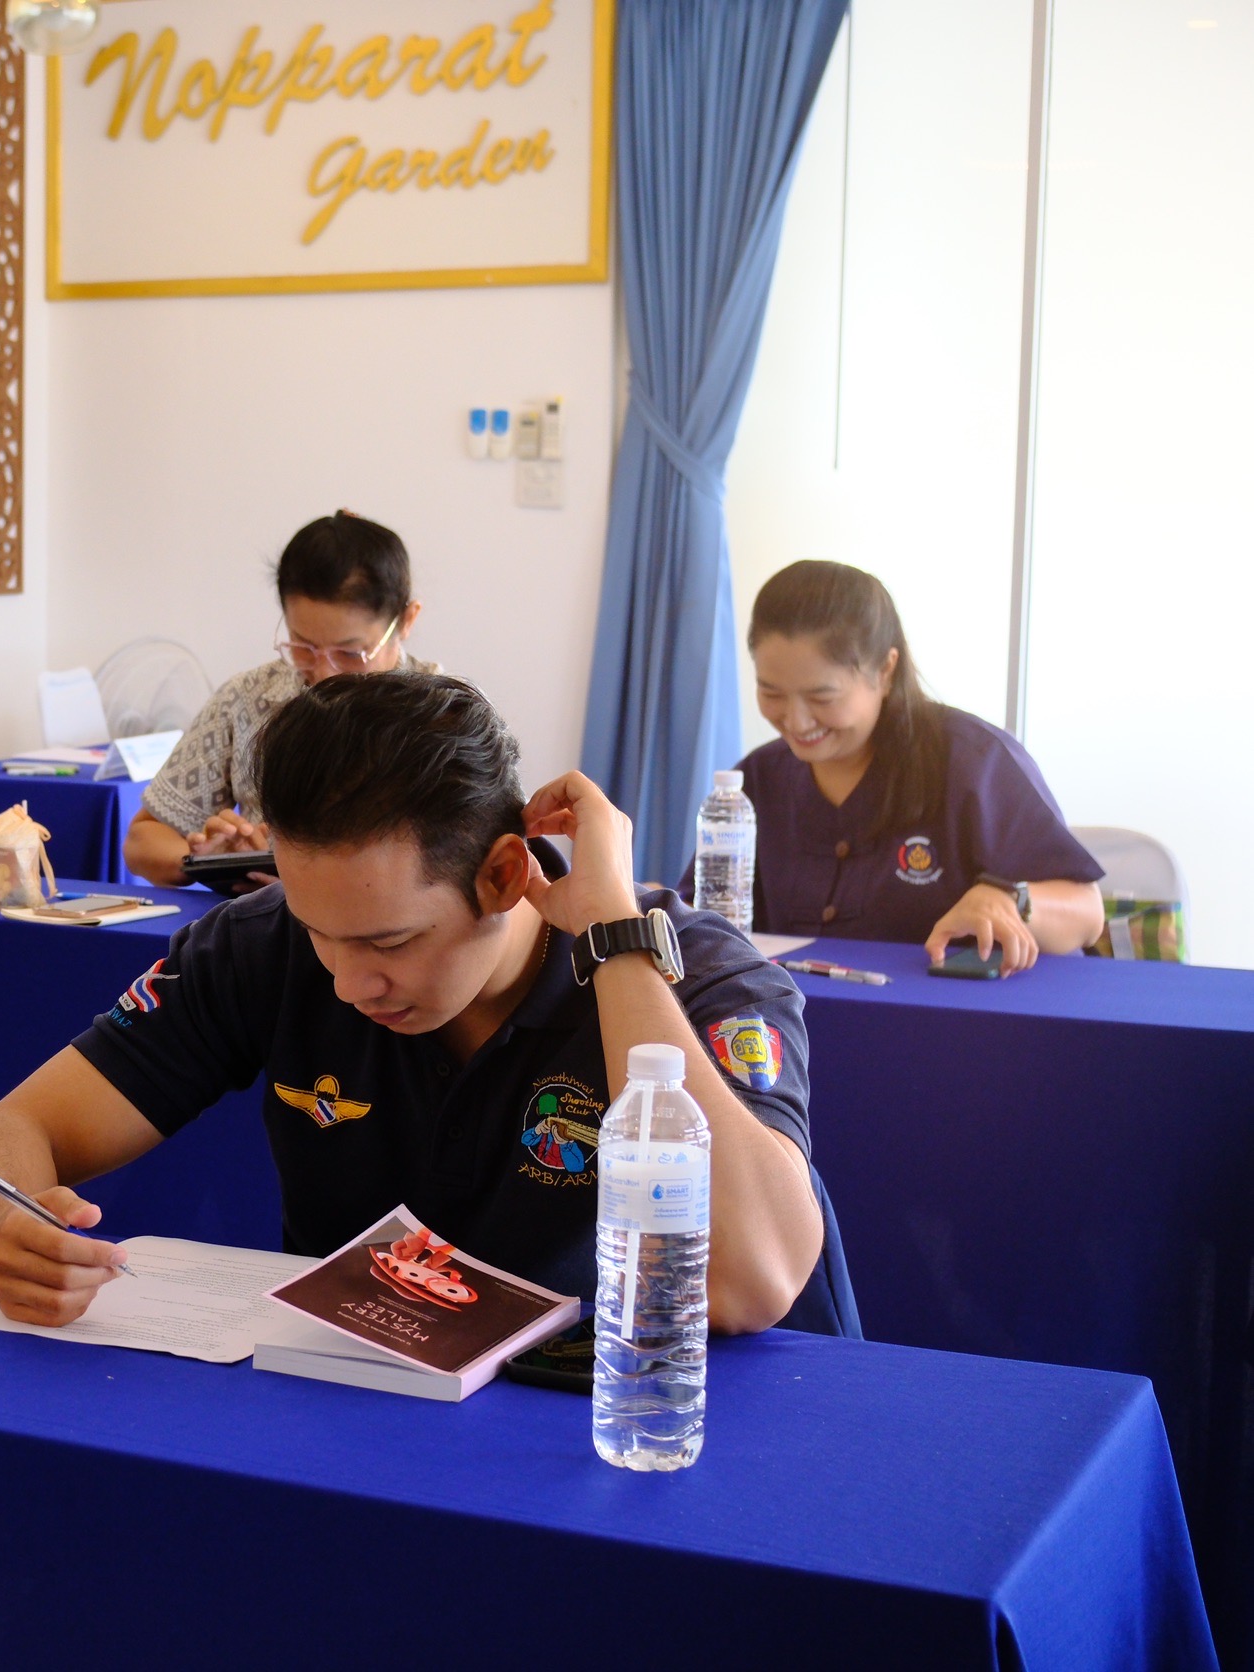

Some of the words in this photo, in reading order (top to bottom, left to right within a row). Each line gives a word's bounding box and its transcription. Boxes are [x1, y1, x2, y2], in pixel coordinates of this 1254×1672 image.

[84, 0, 554, 142] Nopparat
[300, 118, 556, 247] Garden
[532, 1071, 595, 1095] Narathiwat
[560, 1092, 605, 1111] Shooting
[565, 1105, 591, 1116] Club
[340, 1302, 430, 1342] MYSTERY
[362, 1301, 422, 1331] TALES
